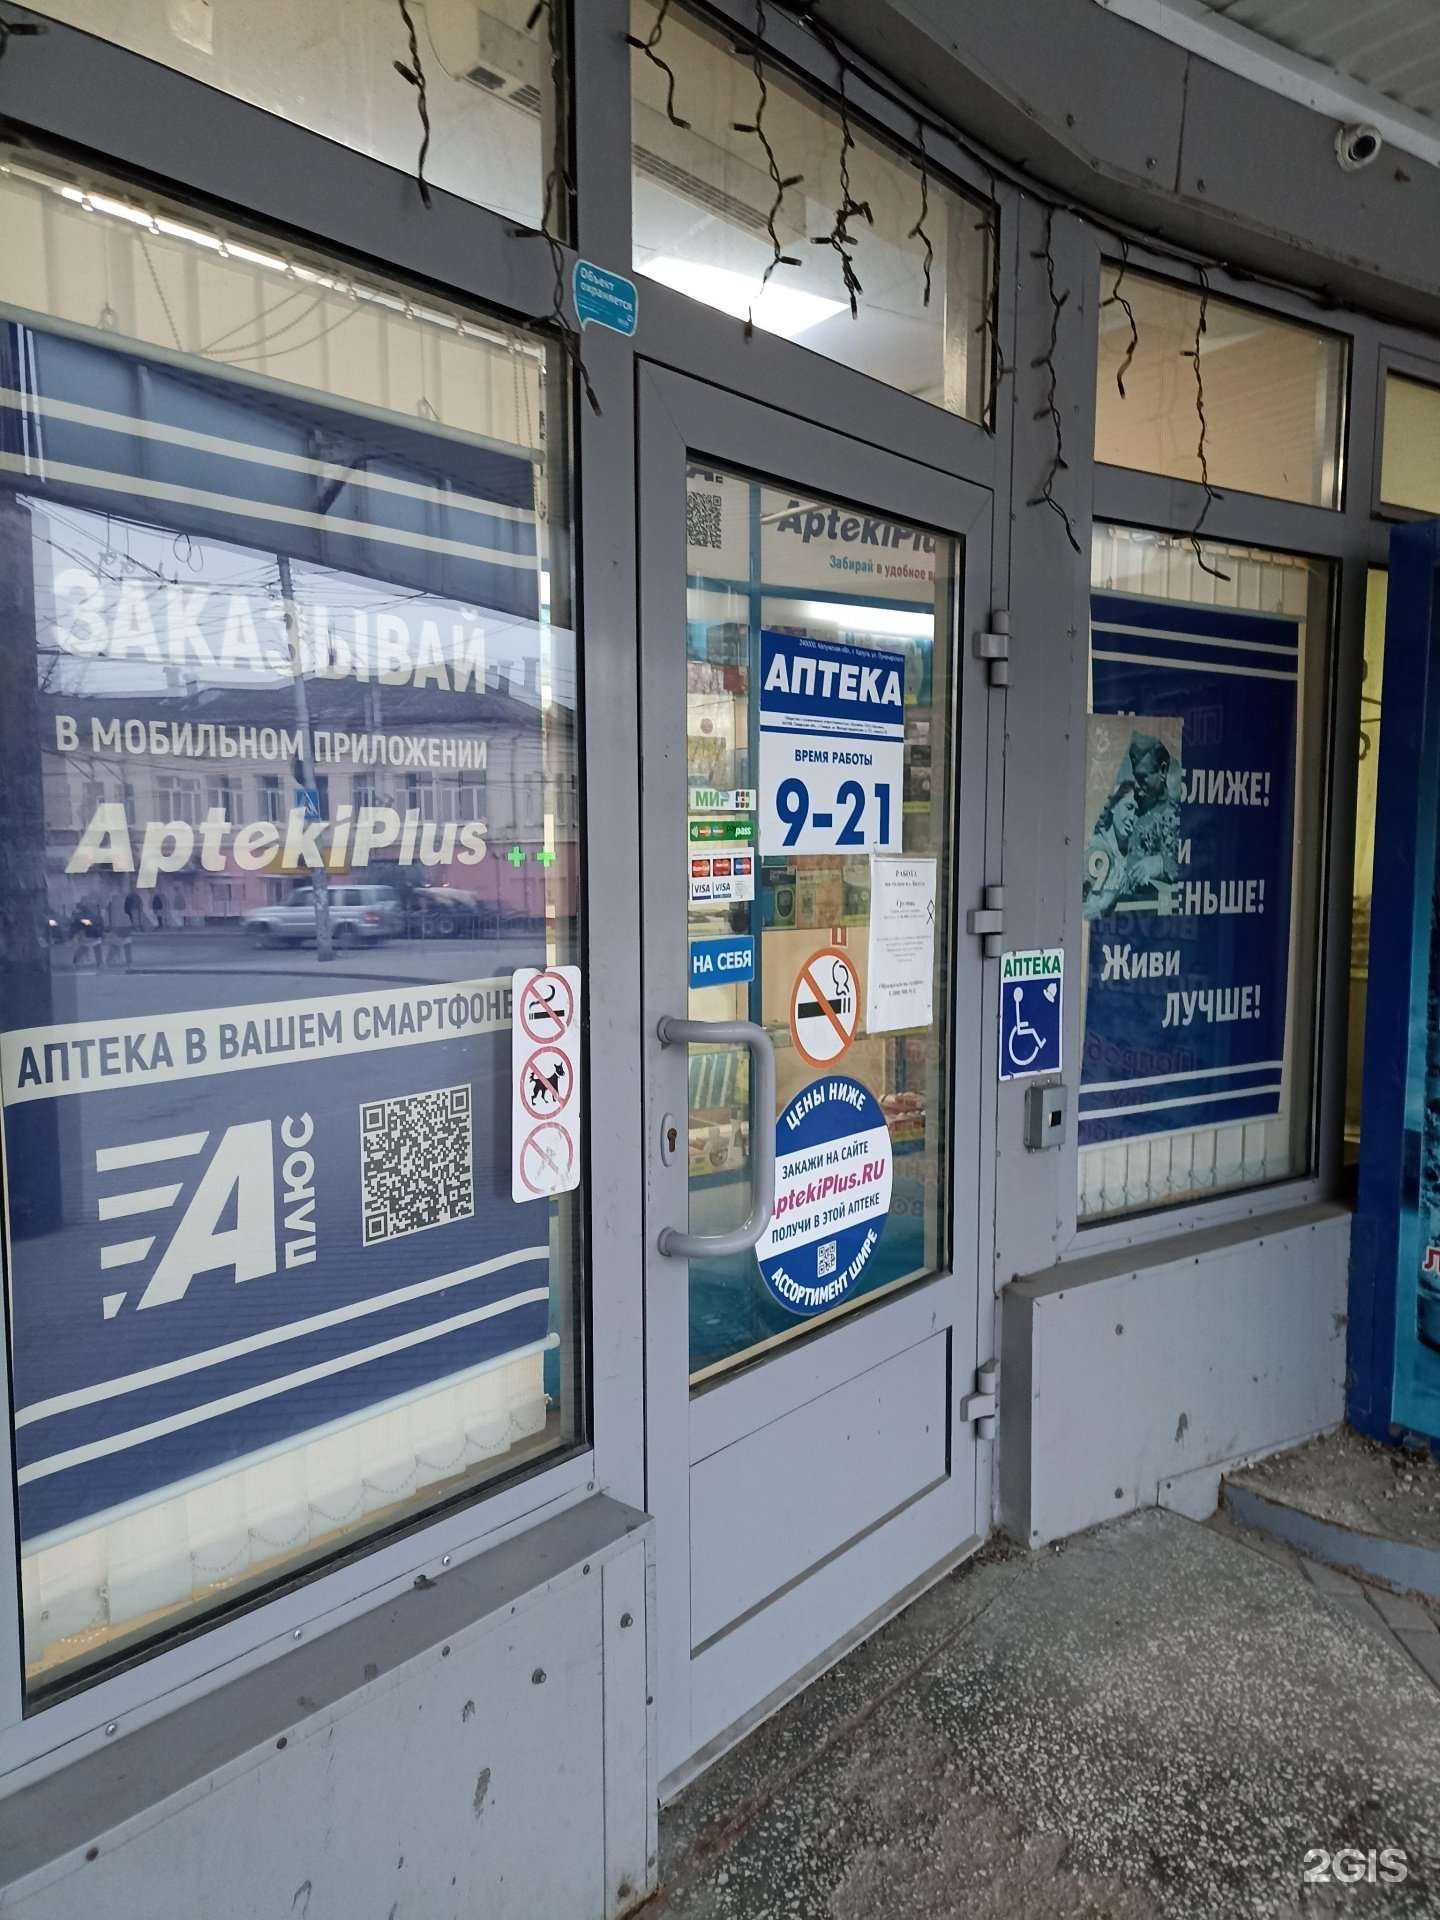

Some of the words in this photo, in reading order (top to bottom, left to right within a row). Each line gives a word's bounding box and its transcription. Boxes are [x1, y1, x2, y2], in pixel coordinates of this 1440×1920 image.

[829, 555, 873, 573] Забирай
[52, 568, 487, 695] ЗАКАЗЫВАЙ
[764, 653, 902, 707] АПТЕКА
[55, 715, 79, 752] В
[92, 716, 303, 761] МОБИЛЬНОМ
[314, 731, 488, 770] ПРИЛОЖЕНИИ
[794, 749, 829, 765] ВРЕМЯ
[832, 750, 873, 766] РАБОТЫ
[695, 790, 729, 807] МИР
[64, 802, 490, 889] AptekiPlus
[694, 884, 711, 893] VISA
[715, 882, 731, 891] VISA
[692, 955, 714, 974] НА
[717, 950, 752, 970] СЕБЯ
[1003, 955, 1062, 978] АПТЕКА
[1101, 943, 1181, 982] Живи
[1161, 984, 1261, 1029] ЛУЧШЕ!
[17, 1034, 175, 1089] АПТЕКА
[186, 1028, 207, 1065] В
[220, 1010, 344, 1060] ВАШЕМ
[785, 1084, 826, 1131] ЦЕНЫ
[828, 1082, 866, 1112] НИЖЕ
[782, 1155, 824, 1180] ЗАКАЖИ
[826, 1151, 839, 1166] НА
[841, 1140, 869, 1161] САЙТЕ
[771, 1158, 886, 1219] ptekiPlus.RU
[771, 1218, 811, 1244] ПОЛУЧИ
[813, 1214, 820, 1227] В
[822, 1204, 846, 1226] ЭТОЙ
[847, 1191, 880, 1216] АПТЕКЕ
[771, 1266, 850, 1307] АССОРТИМЕНТ
[848, 1227, 879, 1281] ШИРЕ
